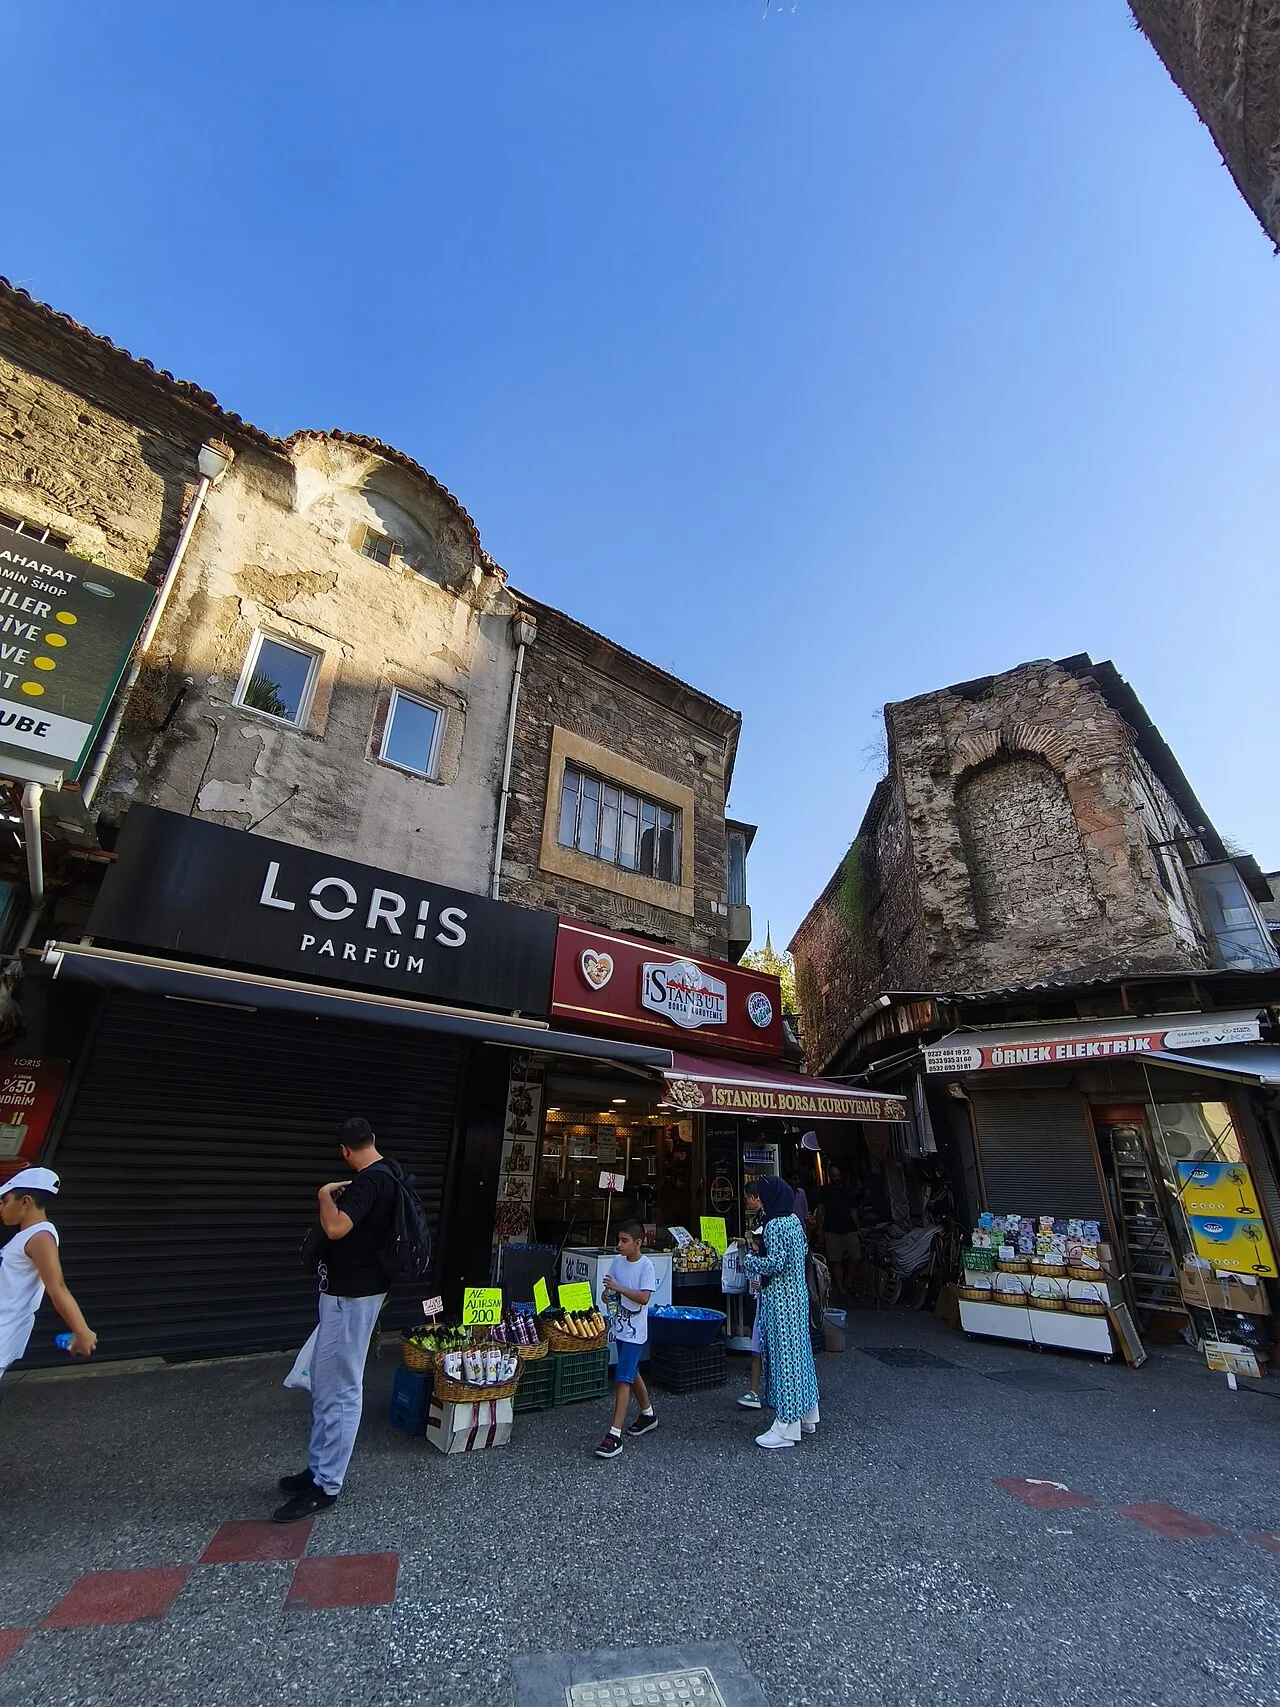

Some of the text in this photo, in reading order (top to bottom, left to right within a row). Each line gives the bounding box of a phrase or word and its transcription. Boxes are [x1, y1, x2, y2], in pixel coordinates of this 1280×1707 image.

[31, 578, 67, 597] SHOP
[300, 933, 425, 974] PARFÜM
[991, 1036, 1152, 1066] ÖRNEK ELEKTRİK
[2, 1078, 36, 1094] %50
[711, 1084, 881, 1119] İSTANBUL BORSA KURUYEMİŞ
[469, 1289, 485, 1299] NE
[469, 1309, 494, 1324] 200
